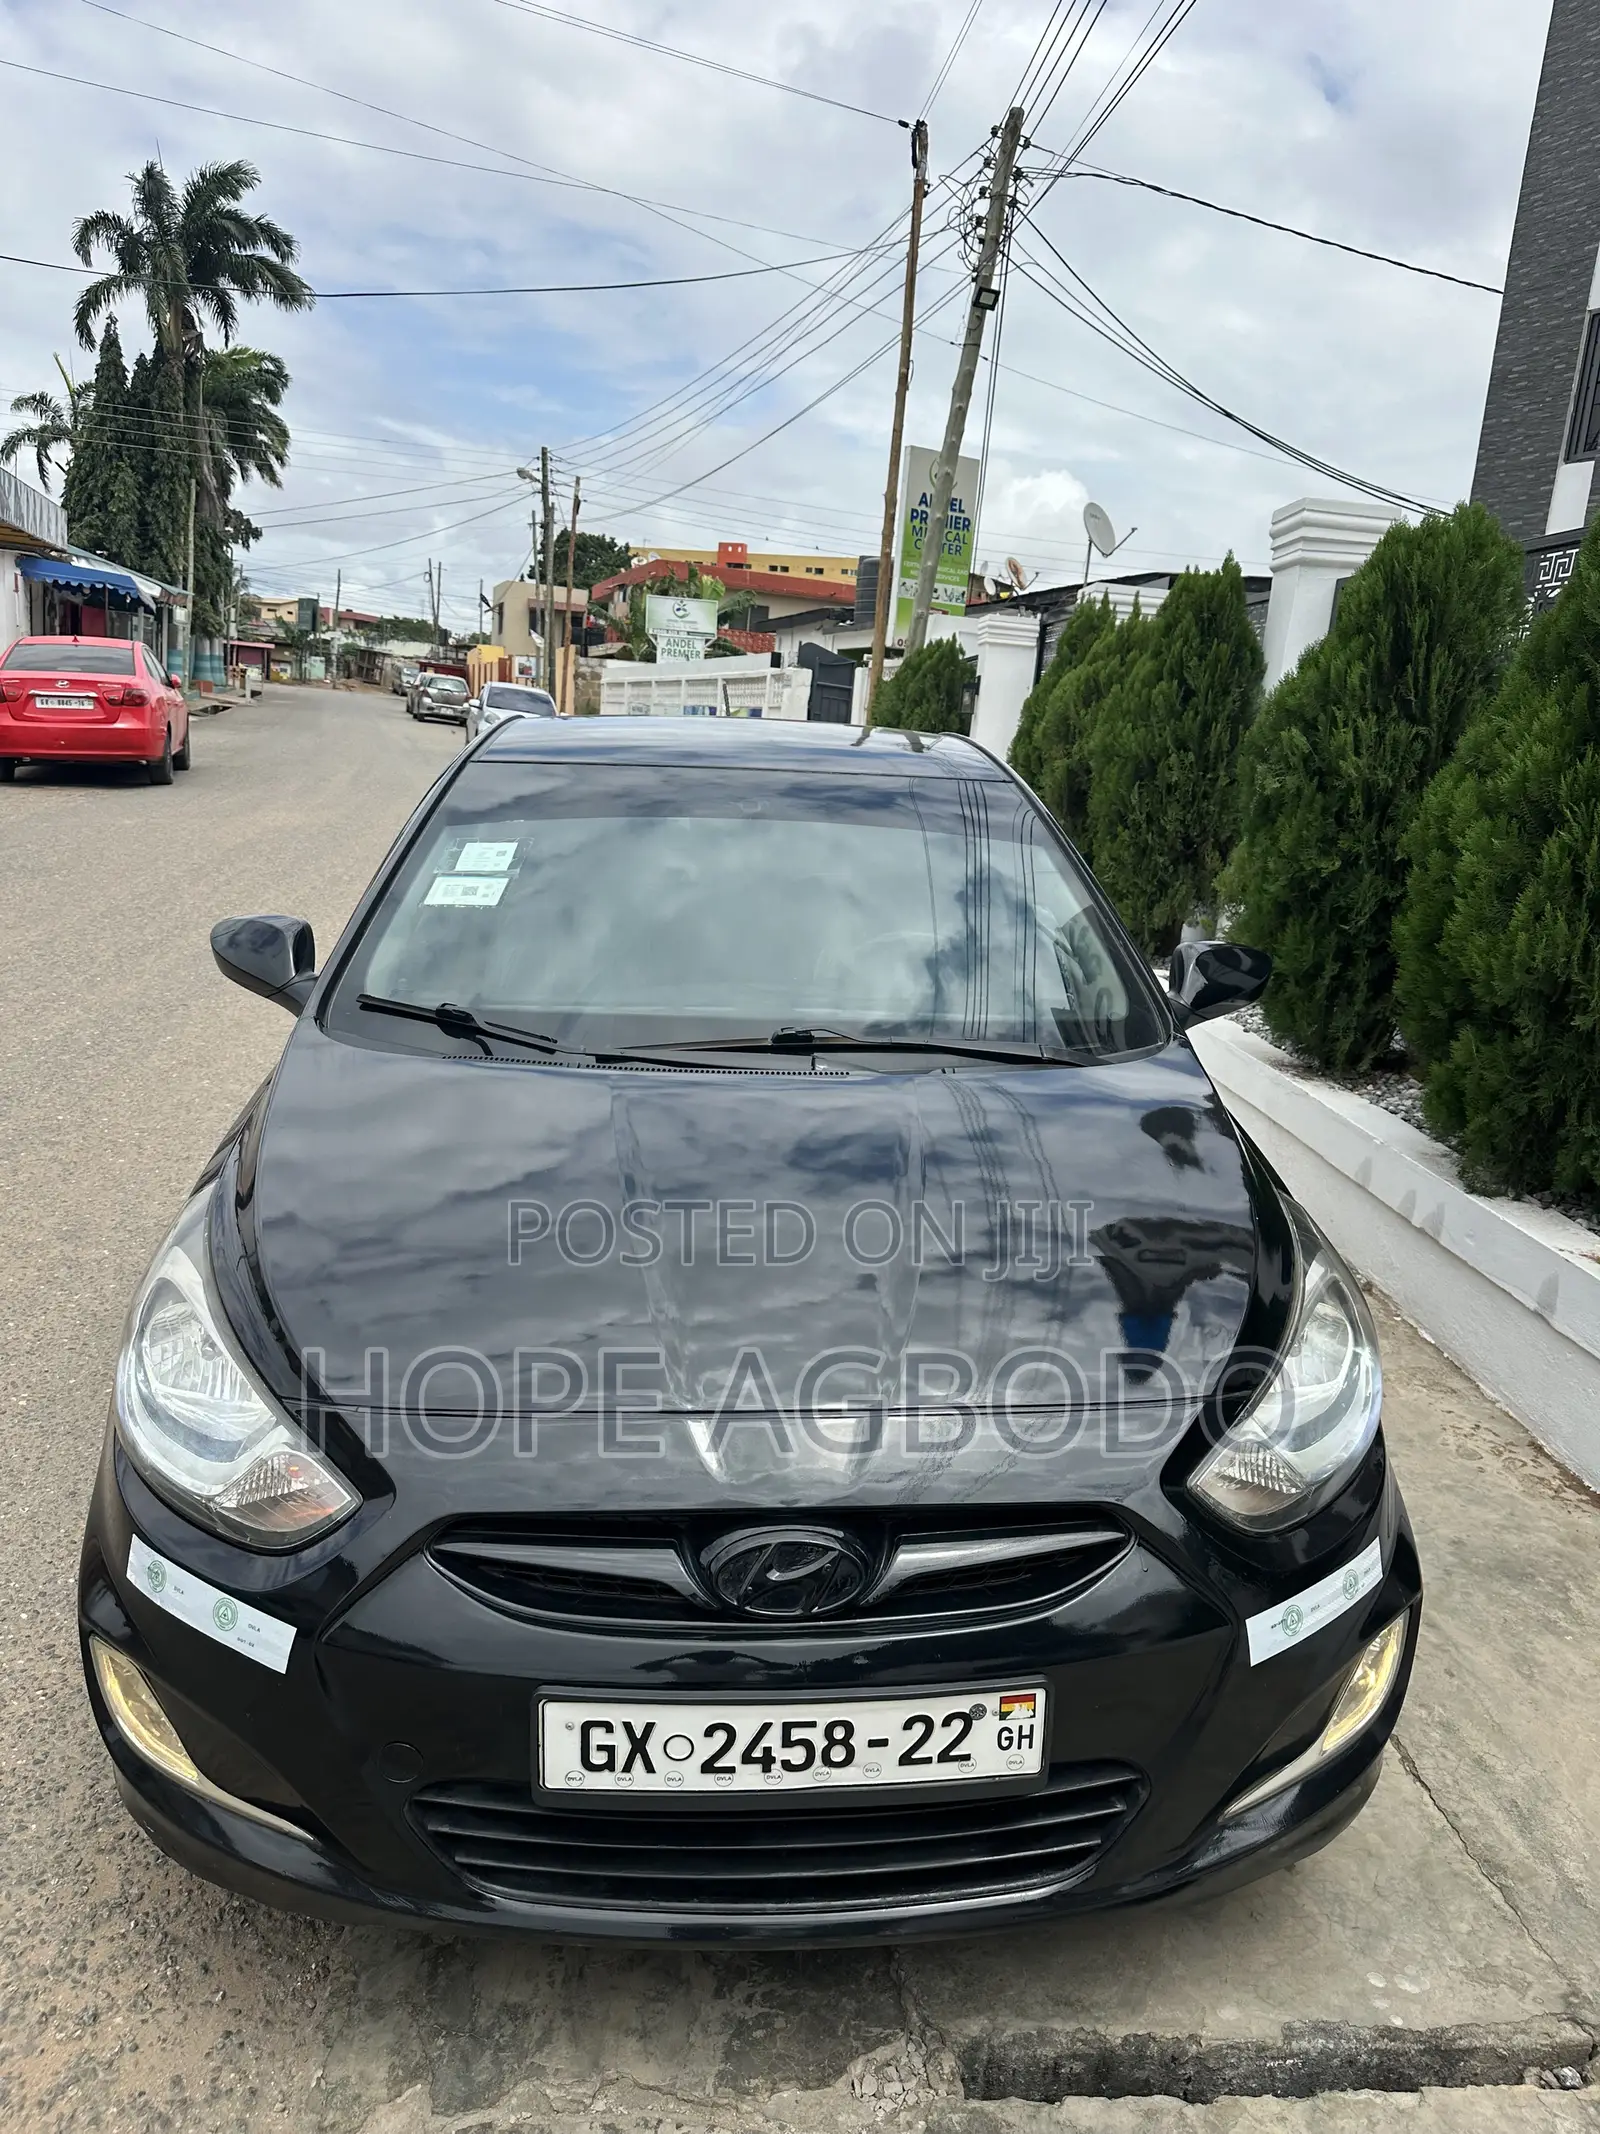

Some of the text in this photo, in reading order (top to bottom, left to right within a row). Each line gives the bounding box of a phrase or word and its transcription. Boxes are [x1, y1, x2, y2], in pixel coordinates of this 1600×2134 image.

[918, 492, 965, 514] AEL
[910, 508, 971, 533] PRIER
[911, 525, 967, 545] MCAL
[914, 538, 962, 556] CTER
[661, 647, 701, 659] PREMIER
[666, 638, 697, 650] ANDEL
[580, 1720, 657, 1775] GX
[997, 1724, 1035, 1751] GH
